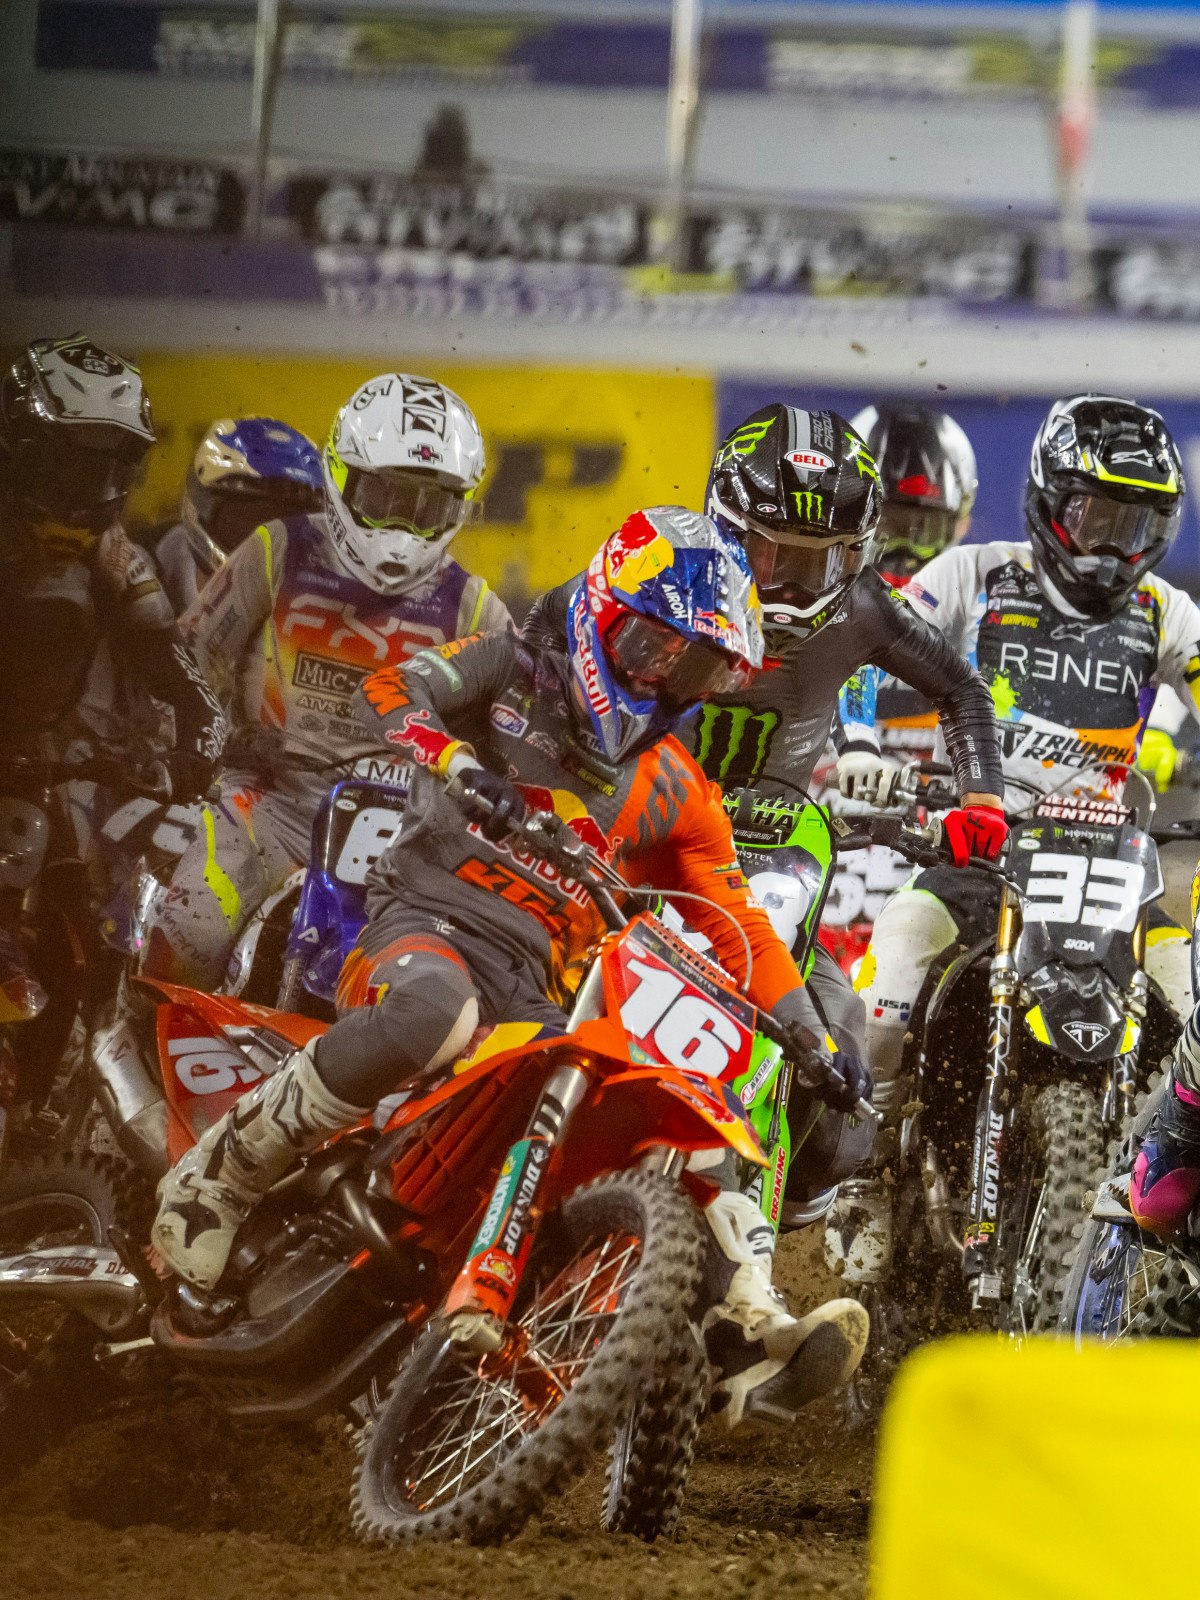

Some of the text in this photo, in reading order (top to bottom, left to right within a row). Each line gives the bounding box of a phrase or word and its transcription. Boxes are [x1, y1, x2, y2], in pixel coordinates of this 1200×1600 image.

[793, 454, 827, 467] BELL
[661, 583, 688, 620] AIROH
[302, 659, 358, 691] Muc-
[581, 654, 613, 718] Bull
[1031, 731, 1130, 763] TRIUMPH
[1040, 794, 1131, 814] ENTHAL
[1064, 829, 1115, 842] MONSTER
[736, 849, 774, 864] NSTER
[1022, 852, 1147, 933] 33
[621, 957, 743, 1078] 16
[877, 998, 911, 1010] USA
[983, 1110, 1004, 1219] DUNLOP
[769, 1146, 787, 1224] BRAKING
[505, 1161, 542, 1256] DUNLOP
